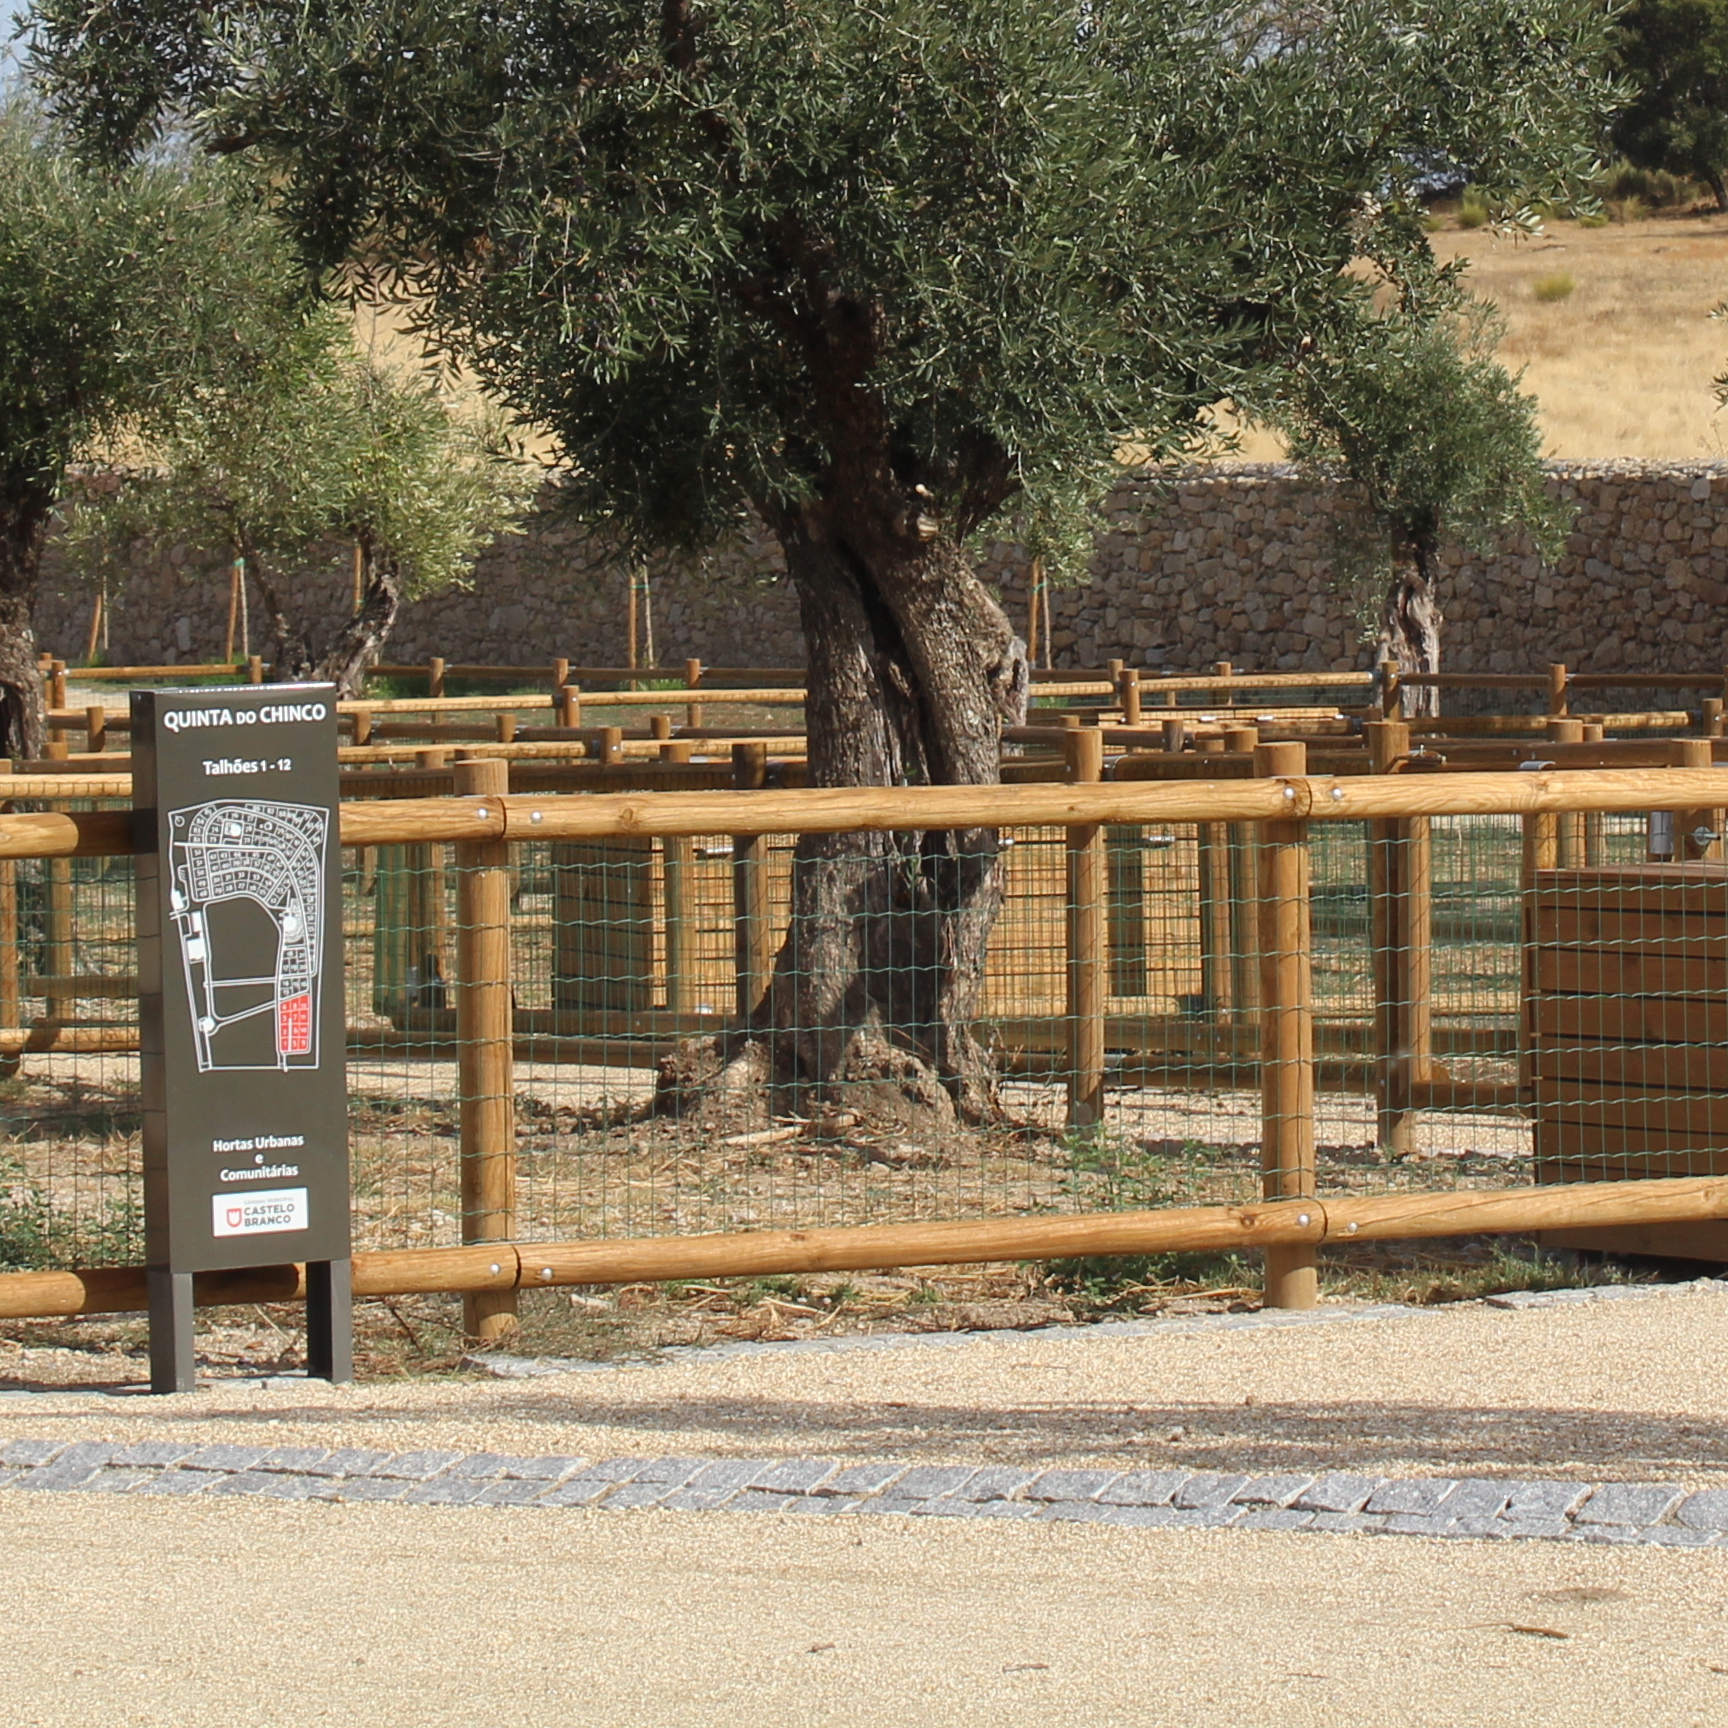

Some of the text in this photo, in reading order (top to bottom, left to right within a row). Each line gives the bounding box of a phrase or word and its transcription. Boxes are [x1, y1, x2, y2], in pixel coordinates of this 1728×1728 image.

[163, 704, 326, 733] QUINTA DO CHINCO
[202, 758, 258, 776] Talhões
[260, 760, 267, 772] 1
[277, 758, 292, 771] 12
[213, 1135, 304, 1153] Hortas Urbanas
[254, 1154, 264, 1164] e
[220, 1164, 299, 1182] Comunitárias
[244, 1203, 295, 1216] CASTELO
[244, 1215, 291, 1227] BRANCO
